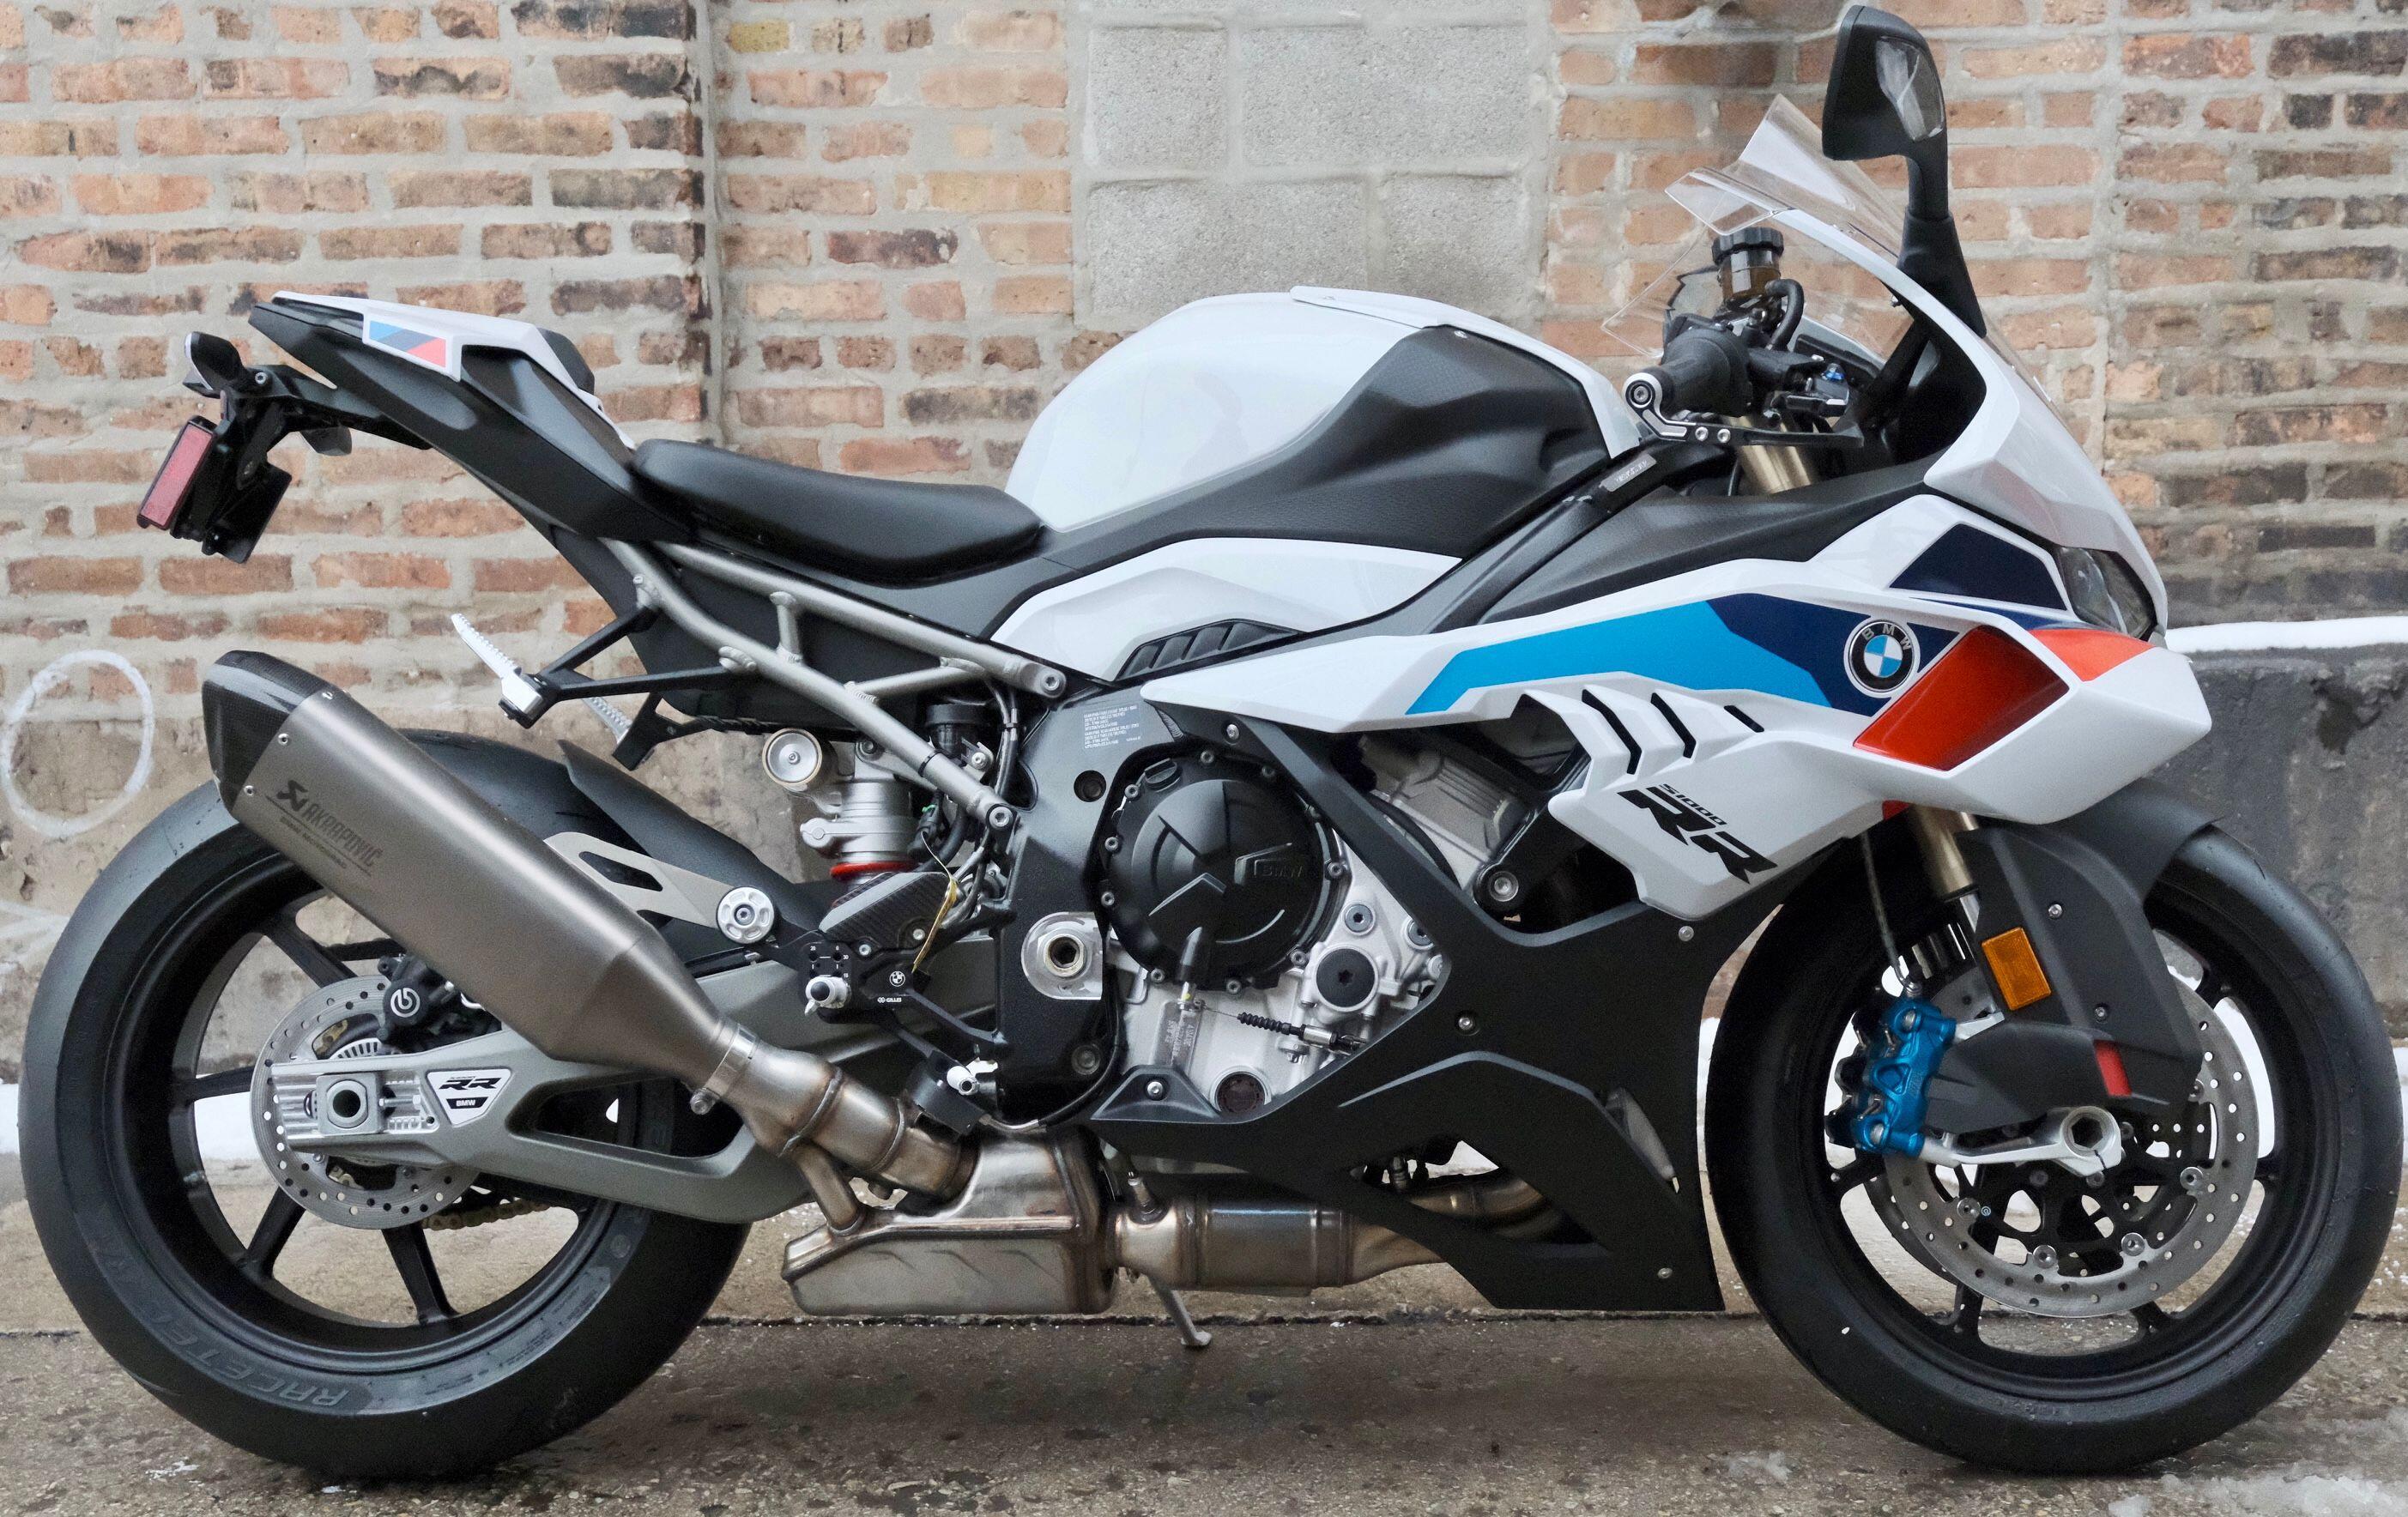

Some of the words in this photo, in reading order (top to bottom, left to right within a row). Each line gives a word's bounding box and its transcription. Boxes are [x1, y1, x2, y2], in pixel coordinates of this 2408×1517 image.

[1861, 623, 1911, 650] BMW
[1658, 783, 1727, 825] S1000
[1616, 785, 1778, 885] RR
[439, 1077, 502, 1091] RR
